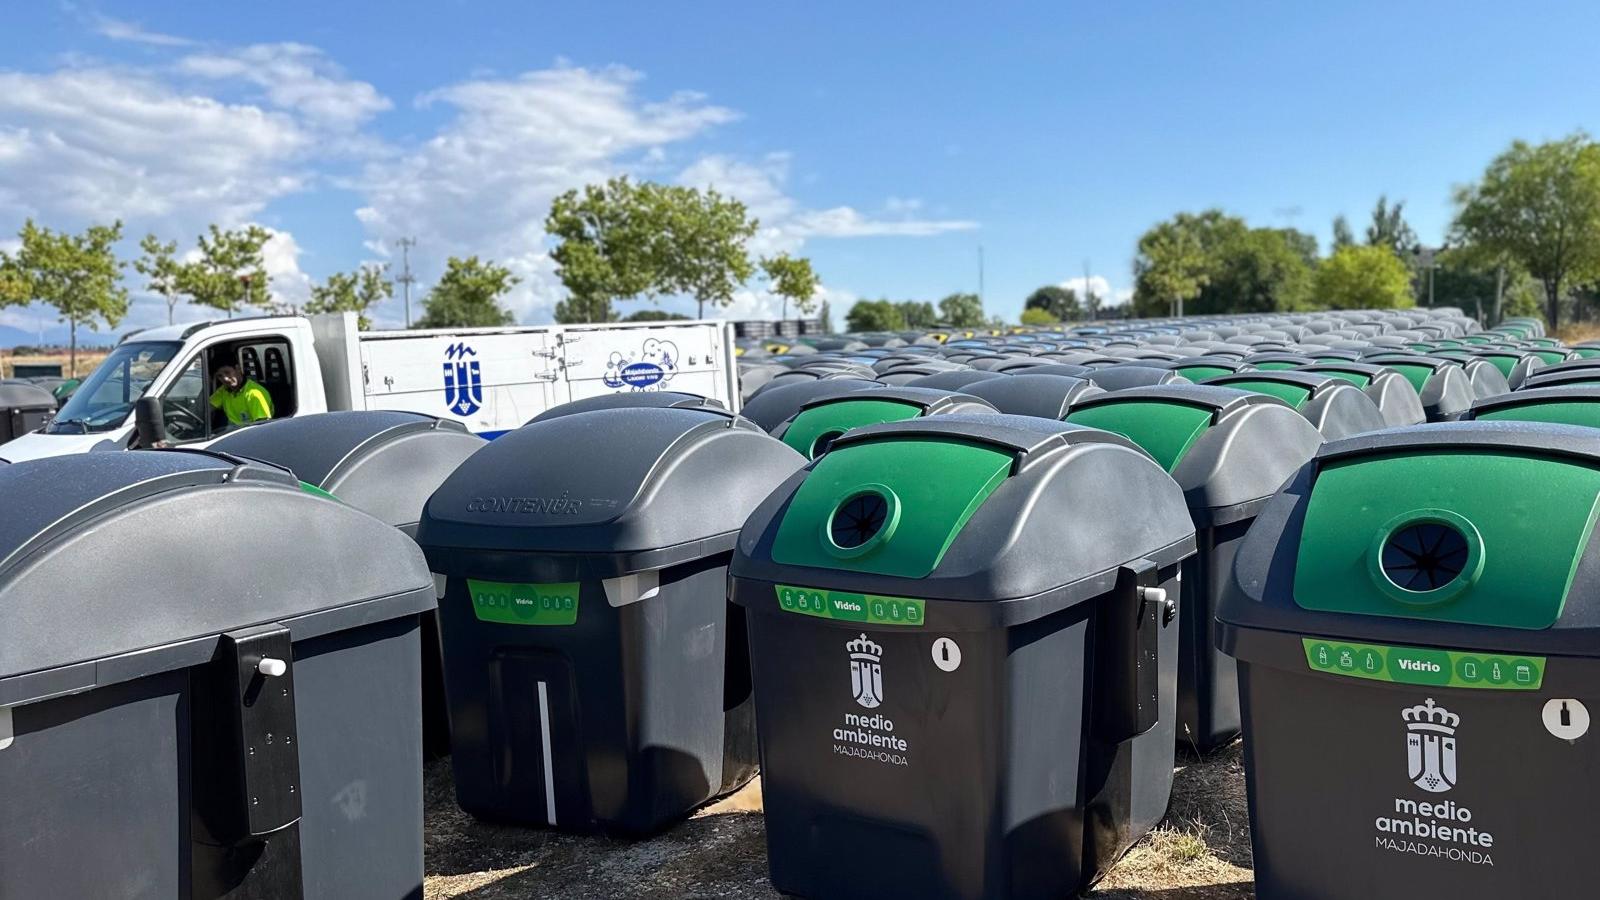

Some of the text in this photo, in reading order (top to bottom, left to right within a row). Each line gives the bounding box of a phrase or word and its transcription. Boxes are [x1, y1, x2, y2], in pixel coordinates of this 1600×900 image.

[834, 600, 861, 612] Vidrio
[1398, 659, 1441, 673] Vidrio
[845, 713, 894, 732] medio
[833, 726, 907, 751] ambiente
[833, 744, 908, 765] MAJADAHONDA
[1395, 798, 1472, 823] medio
[1375, 815, 1493, 848] ambiente
[1376, 836, 1494, 866] MAJADAHONDA
